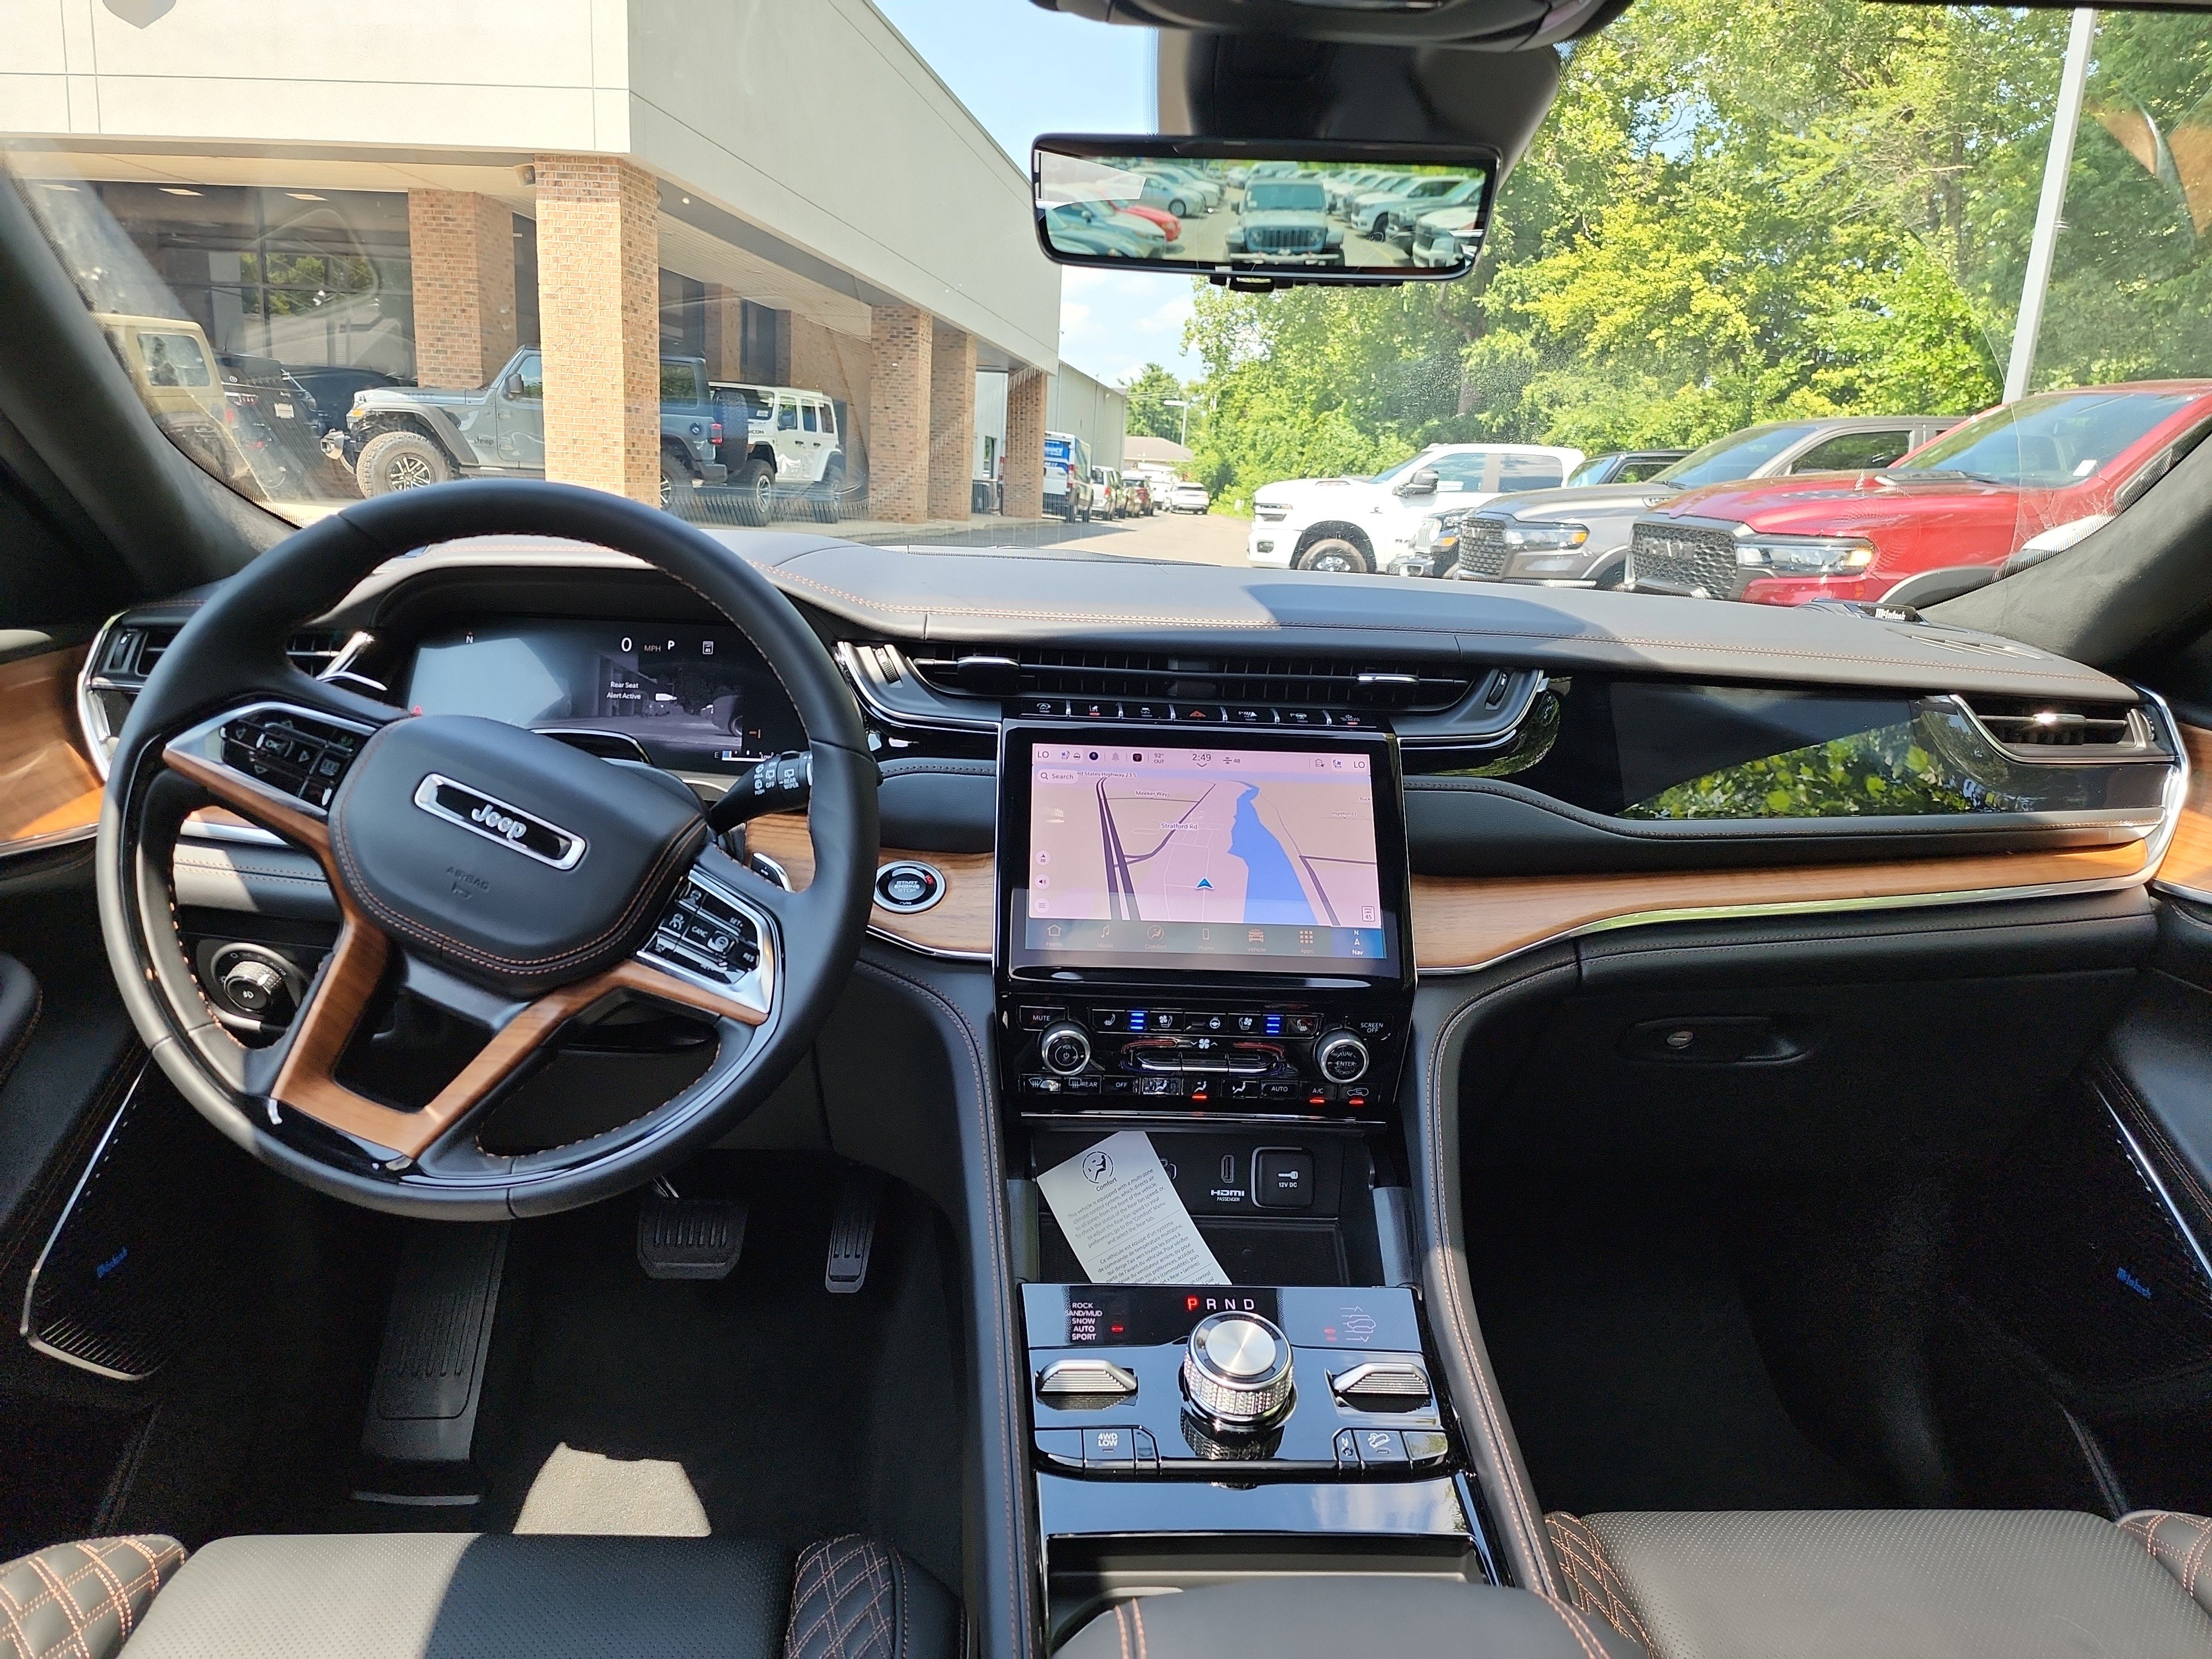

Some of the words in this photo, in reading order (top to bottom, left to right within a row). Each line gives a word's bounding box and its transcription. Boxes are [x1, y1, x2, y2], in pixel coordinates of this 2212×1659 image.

[1875, 608, 1906, 620] McIntosh
[466, 635, 473, 644] N
[667, 640, 675, 650] P
[1192, 753, 1212, 762] 2:49
[472, 804, 527, 839] Jeep
[1095, 1176, 1118, 1192] Comfort
[1076, 1202, 1093, 1214] vehicle
[1095, 1188, 1118, 1204] equipped
[1088, 1203, 1105, 1215] control
[1120, 1186, 1134, 1197] which
[1133, 1178, 1149, 1190] directs
[1117, 1197, 1129, 1207] front
[1092, 1226, 1107, 1238] adjust
[1130, 1204, 1145, 1215] speed
[1080, 1224, 1094, 1236] check
[1115, 1229, 1129, 1240] select
[1114, 1261, 1128, 1272] dirige
[1144, 1244, 1159, 1255] toutes
[1164, 1234, 1178, 1244] zones
[1103, 1253, 1129, 1270] commande
[1135, 1259, 1160, 1275] ventilateur
[1194, 1270, 1211, 1282] control
[1188, 1298, 1198, 1311] P
[1207, 1298, 1217, 1310] R
[1225, 1298, 1236, 1310] N
[1244, 1298, 1254, 1310] D
